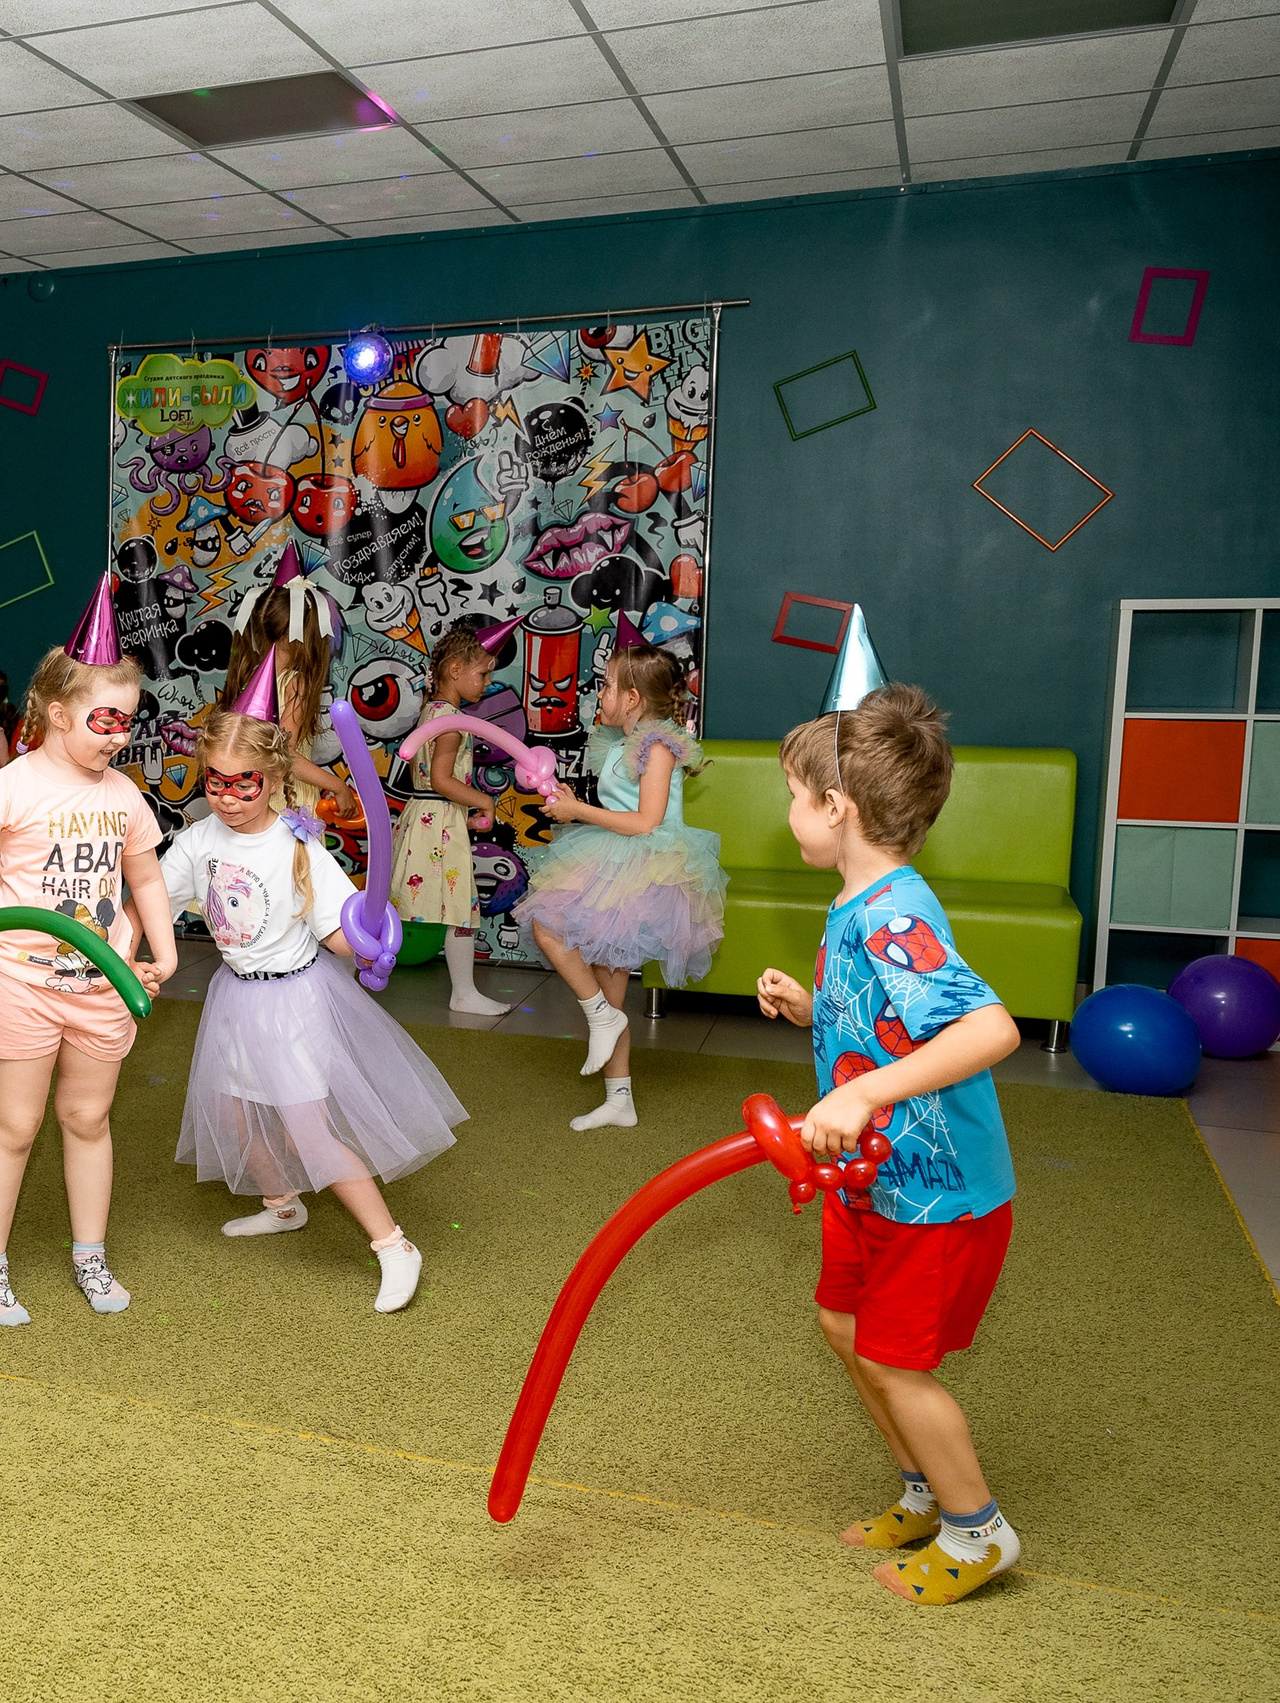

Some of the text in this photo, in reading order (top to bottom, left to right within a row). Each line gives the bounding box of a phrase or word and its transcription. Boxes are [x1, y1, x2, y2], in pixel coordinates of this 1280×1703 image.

[646, 319, 708, 354] BIG
[121, 383, 247, 408] ЖИЛИ-БЫЛИ
[160, 409, 192, 423] LOFT
[121, 618, 180, 650] ечеринка
[48, 811, 128, 839] HAVING
[42, 843, 65, 873] A
[41, 875, 91, 899] HAIR
[970, 1516, 1003, 1539] DINO
